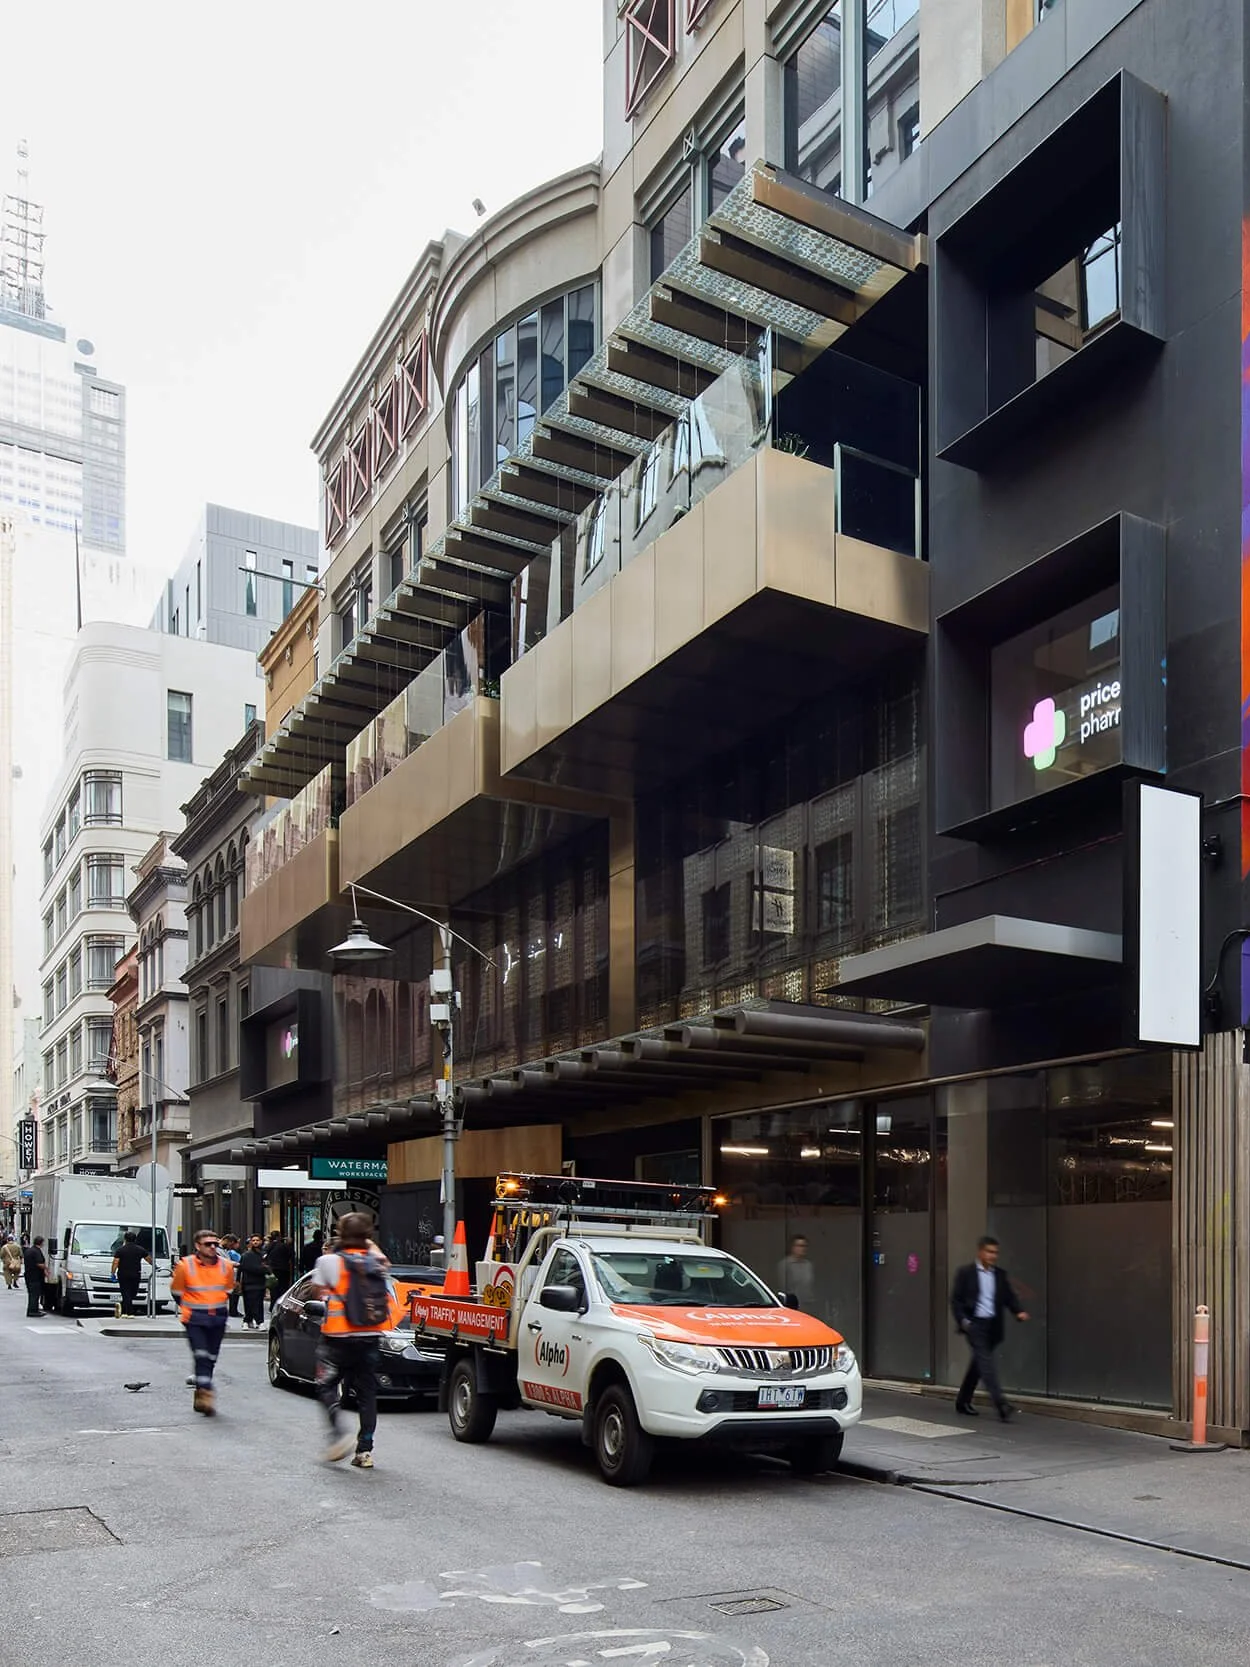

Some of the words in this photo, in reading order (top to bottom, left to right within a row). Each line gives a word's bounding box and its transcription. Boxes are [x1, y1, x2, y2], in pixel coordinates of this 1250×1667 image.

[1080, 681, 1121, 718] price
[24, 1126, 33, 1163] HOWEY
[430, 1305, 456, 1323] TRAFFIC
[457, 1310, 505, 1331] MANAGEMENT
[551, 1388, 578, 1408] ALPHA
